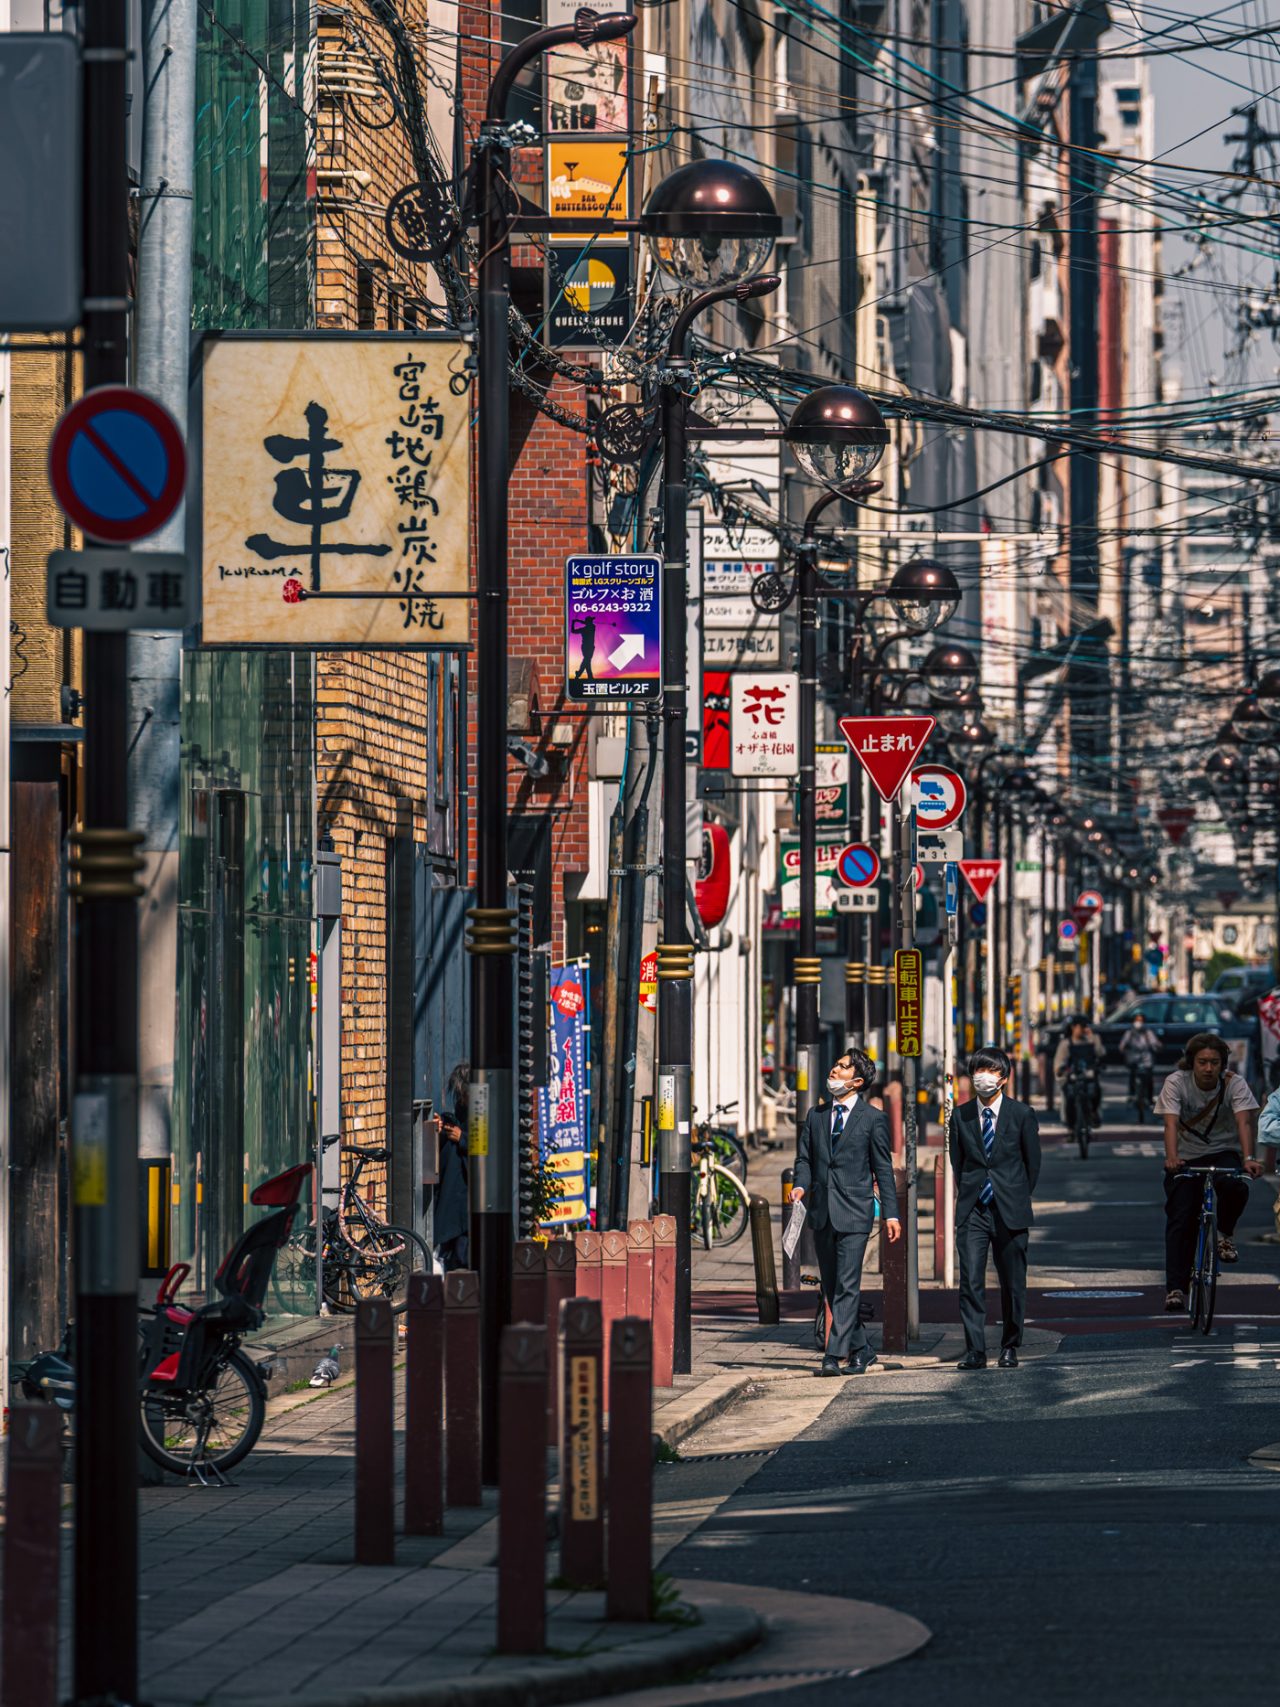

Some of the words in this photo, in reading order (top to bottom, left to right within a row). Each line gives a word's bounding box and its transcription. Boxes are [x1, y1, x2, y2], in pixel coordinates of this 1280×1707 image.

[245, 400, 393, 591] 車
[571, 562, 580, 576] k
[583, 562, 612, 578] golf
[615, 563, 655, 578] story
[55, 566, 183, 613] 自動車
[573, 602, 651, 613] 06-6243-9322
[583, 683, 649, 695] 玉置ビル2F
[743, 685, 788, 725] 花
[736, 743, 795, 755] オザキ花園
[860, 734, 916, 752] 止まれ
[900, 954, 919, 1057] 自転車止まれ
